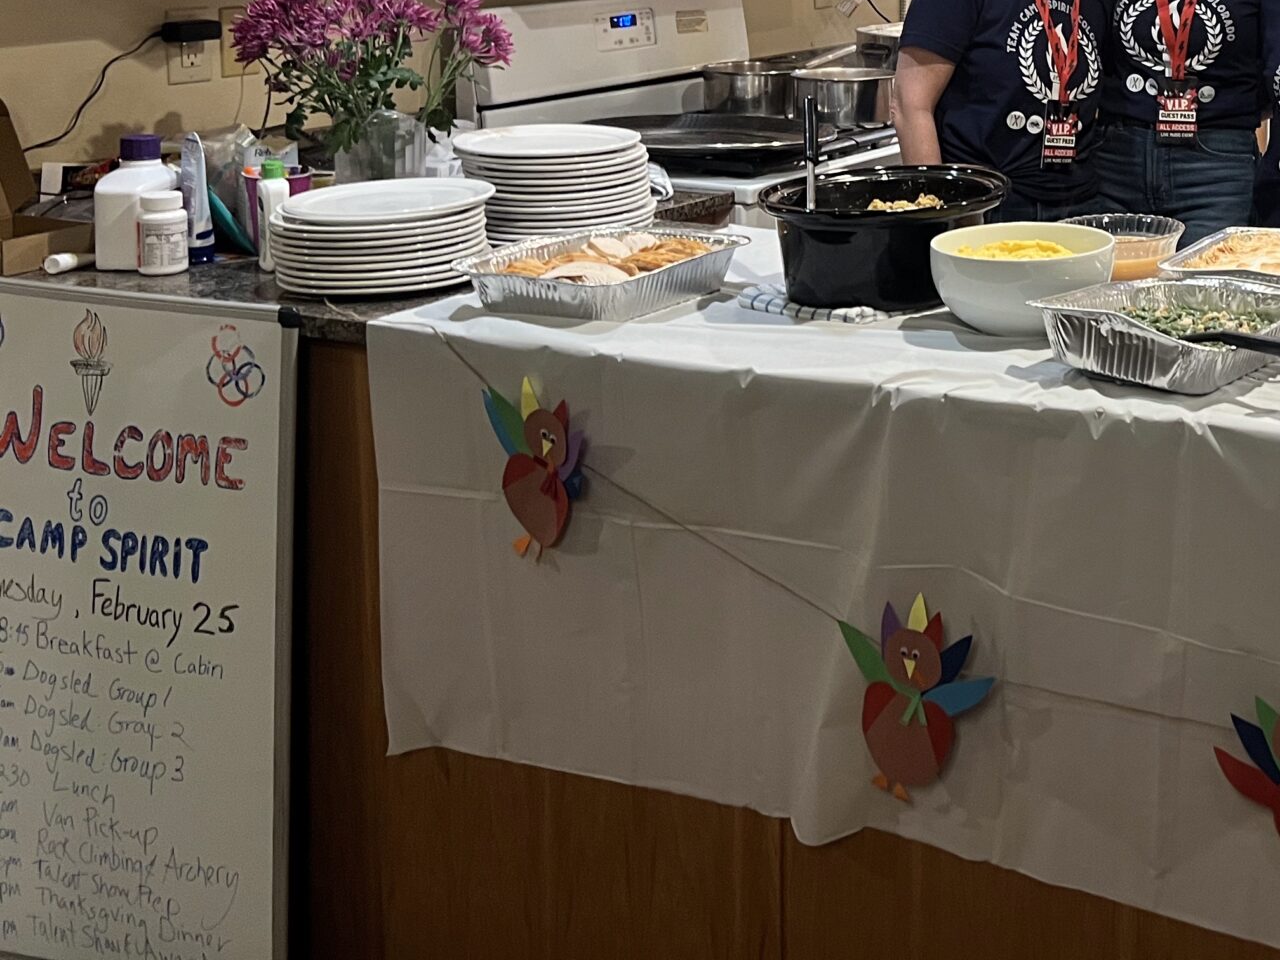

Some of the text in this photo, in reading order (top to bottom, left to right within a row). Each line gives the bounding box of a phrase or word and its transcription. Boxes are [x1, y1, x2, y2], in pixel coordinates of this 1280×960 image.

[1006, 21, 1022, 53] TEAM
[1020, 3, 1038, 22] CAM
[1160, 123, 1170, 131] ALL
[67, 478, 108, 526] to
[0, 508, 208, 583] CAMP SPIRIT
[91, 578, 183, 648] February
[192, 602, 240, 636] 25
[36, 620, 138, 665] Breakfast
[144, 649, 163, 673] @
[174, 652, 224, 680] Cabin
[22, 659, 99, 702] Dogsled
[109, 678, 157, 718] Group
[52, 771, 116, 813] Lunch
[170, 755, 185, 782] 3
[42, 802, 74, 831] Van
[162, 846, 239, 912] Archery
